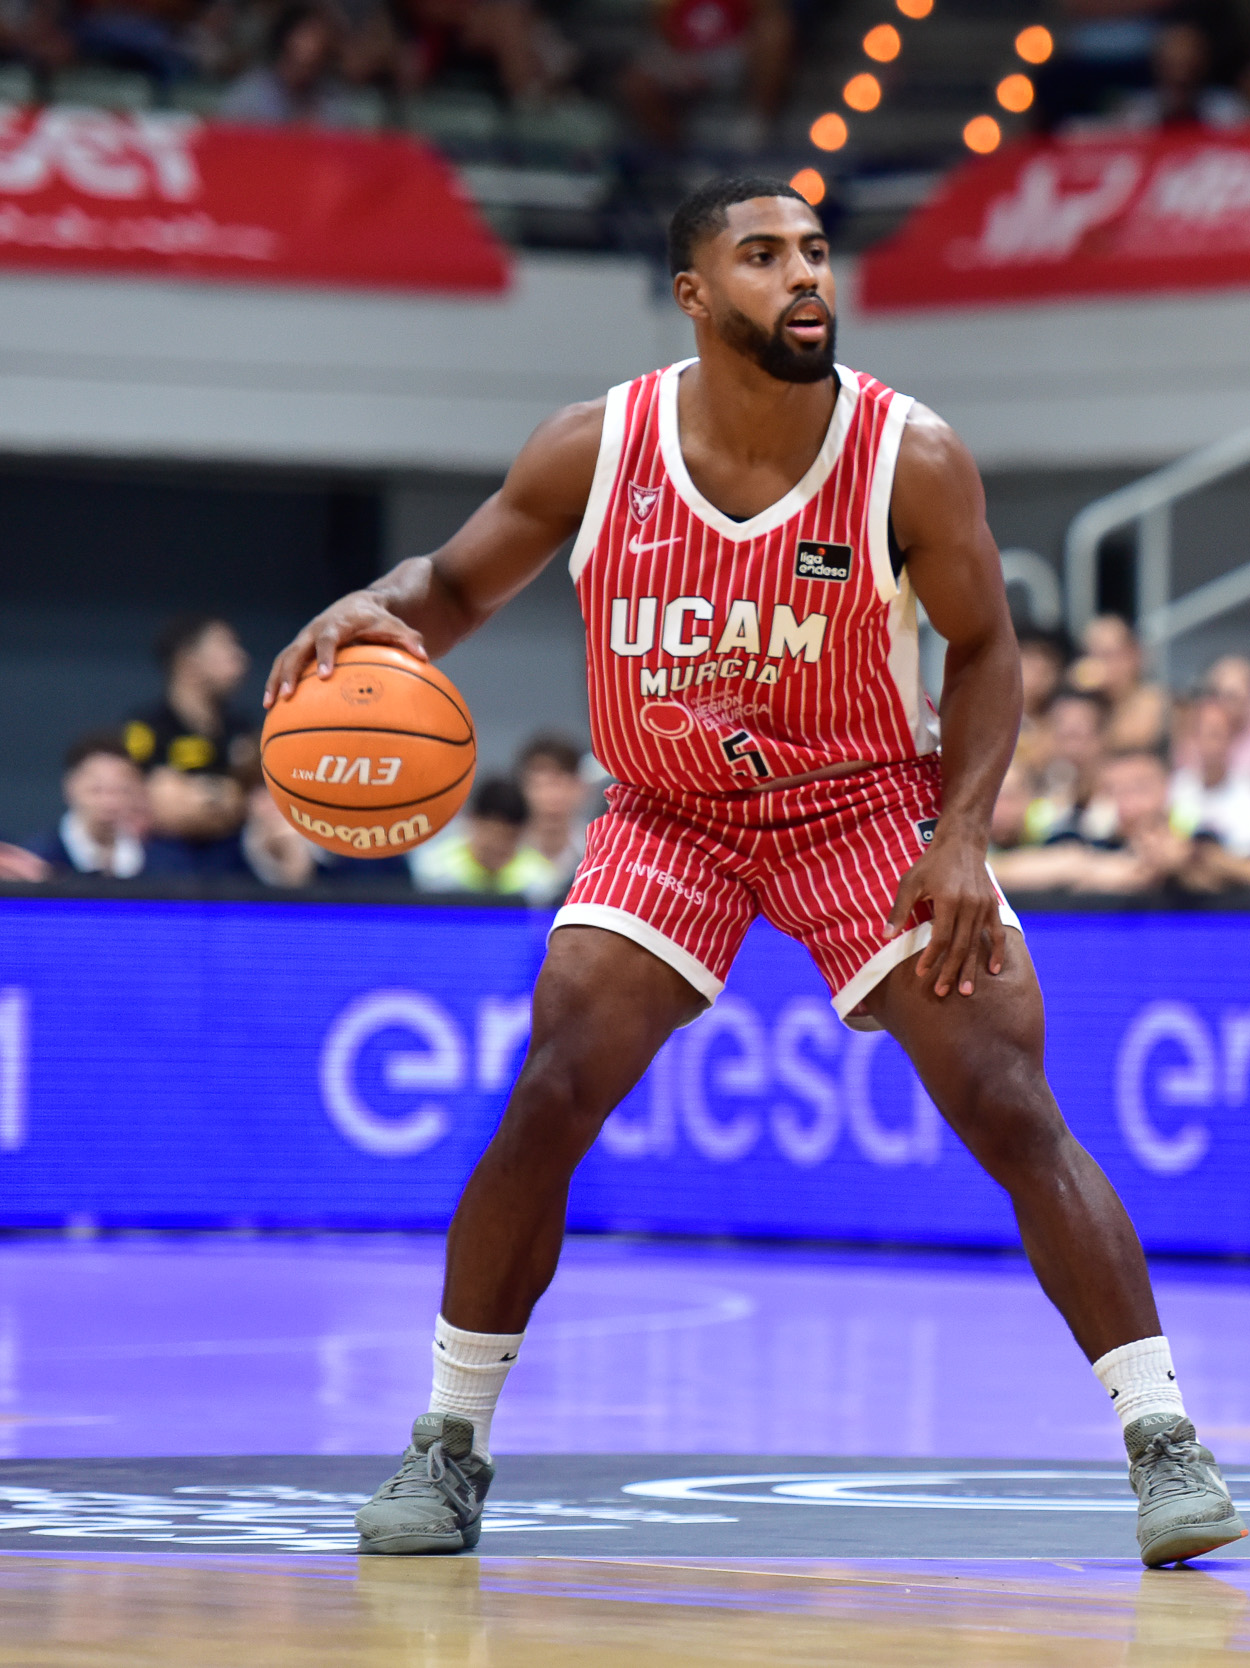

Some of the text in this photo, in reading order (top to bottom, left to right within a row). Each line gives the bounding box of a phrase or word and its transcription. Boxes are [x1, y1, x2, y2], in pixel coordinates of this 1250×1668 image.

[799, 563, 847, 578] endesa
[800, 552, 823, 566] liga
[609, 595, 829, 664] UCAM
[639, 658, 779, 698] MURCIA
[291, 755, 402, 785] EVO NXT
[289, 804, 432, 849] Wilson
[625, 861, 704, 905] INVERSUS
